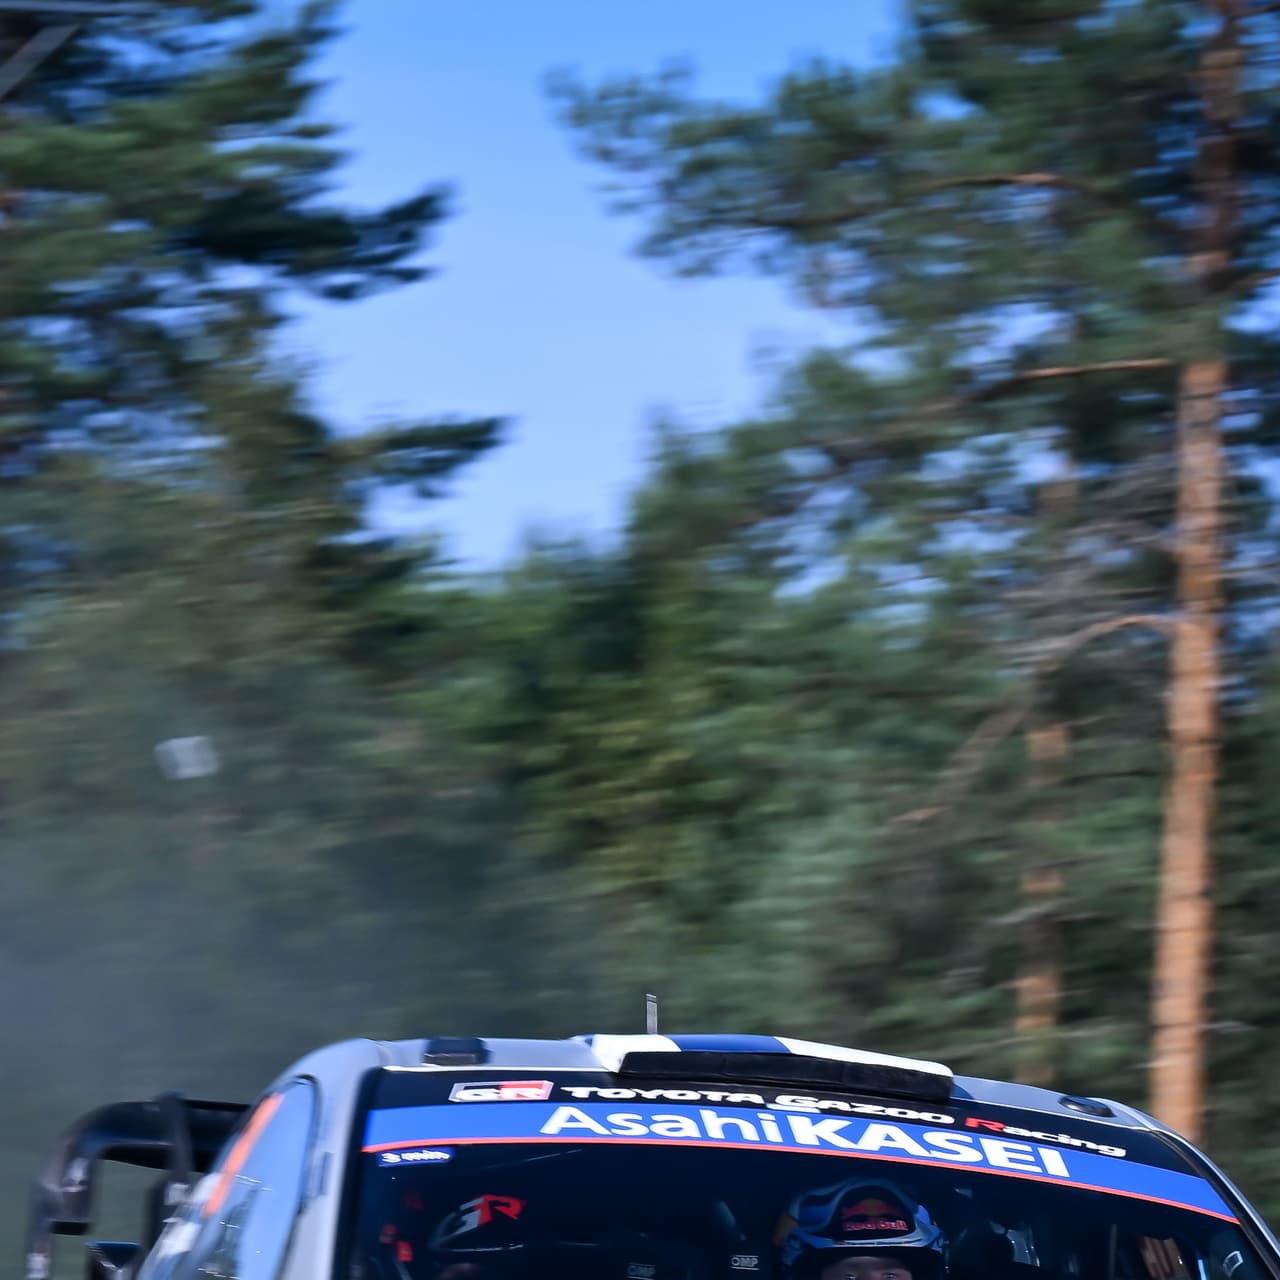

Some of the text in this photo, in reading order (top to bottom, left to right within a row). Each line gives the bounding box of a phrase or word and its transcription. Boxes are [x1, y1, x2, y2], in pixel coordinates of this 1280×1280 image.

[539, 1105, 1070, 1178] AsahiKASEI
[561, 1087, 765, 1104] TOYOTA
[767, 1095, 955, 1125] GAZOO
[965, 1117, 1127, 1158] Racing
